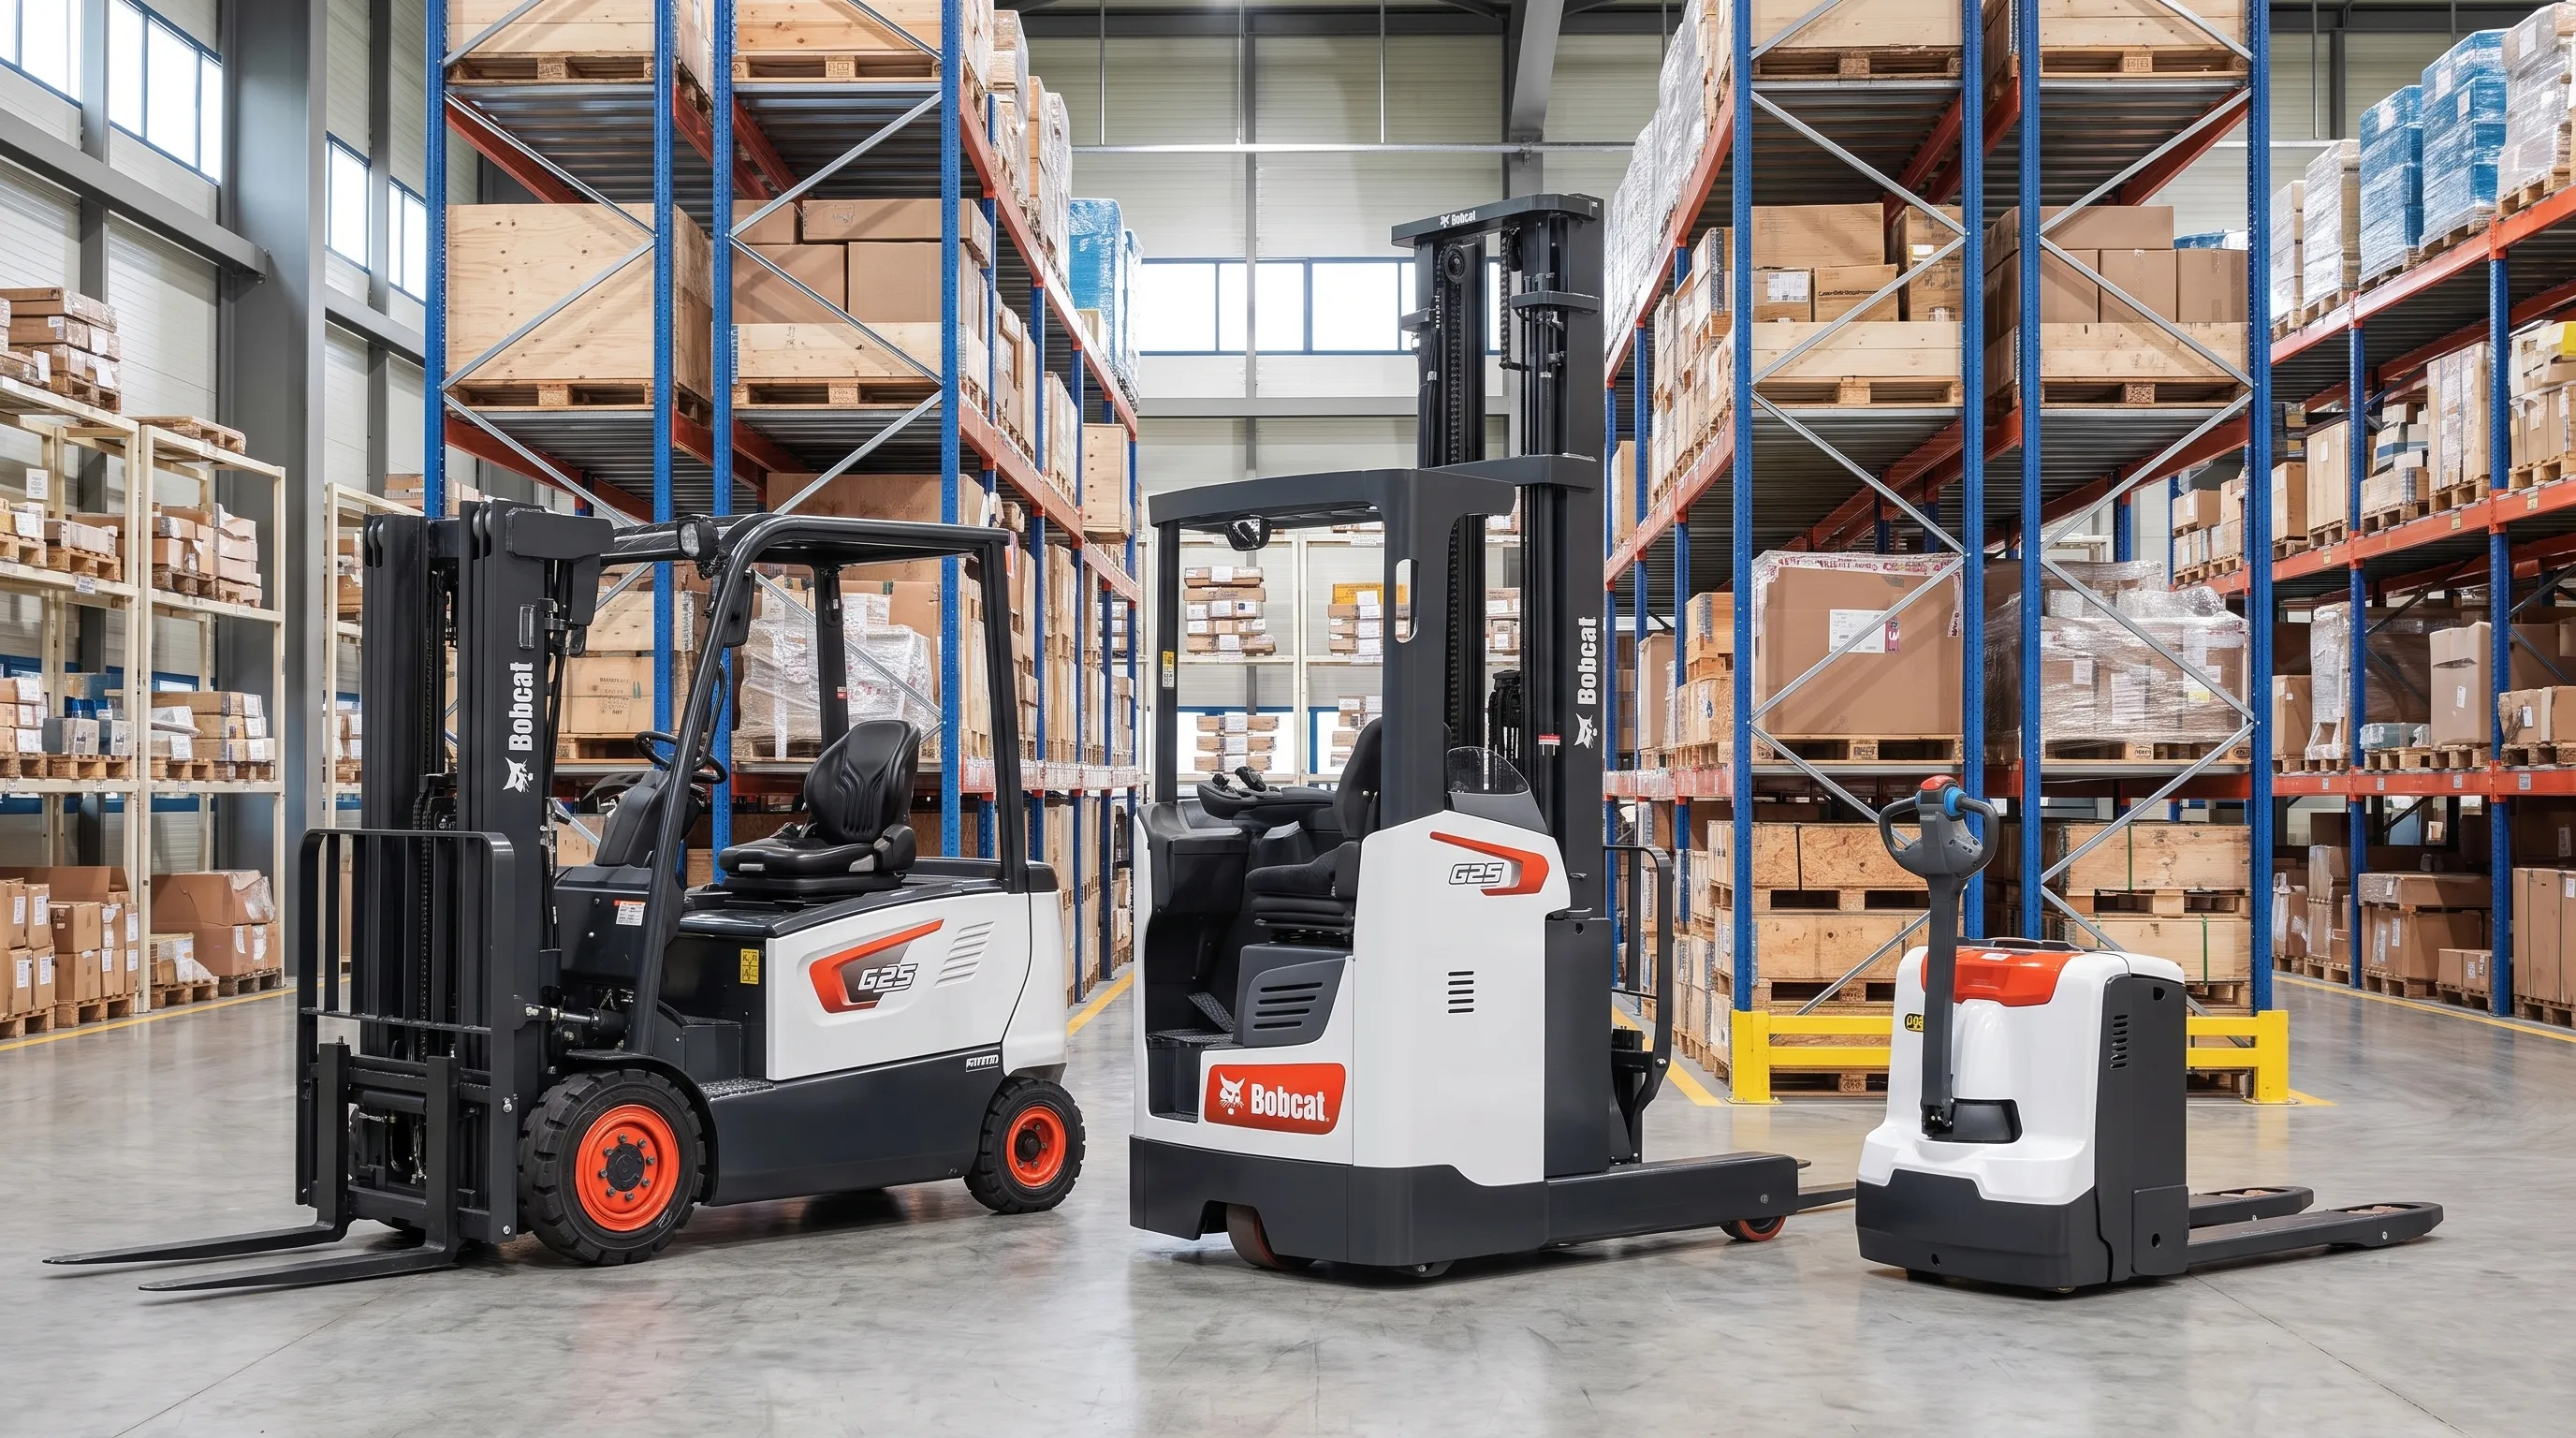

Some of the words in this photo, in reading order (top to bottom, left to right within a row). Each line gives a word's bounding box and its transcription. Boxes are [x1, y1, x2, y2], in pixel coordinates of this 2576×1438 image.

[1577, 616, 1597, 705] Bobcat
[508, 661, 534, 751] Bobcat
[1448, 862, 1505, 885] G25
[857, 962, 918, 991] G25
[1251, 1083, 1325, 1122] Bobcat
